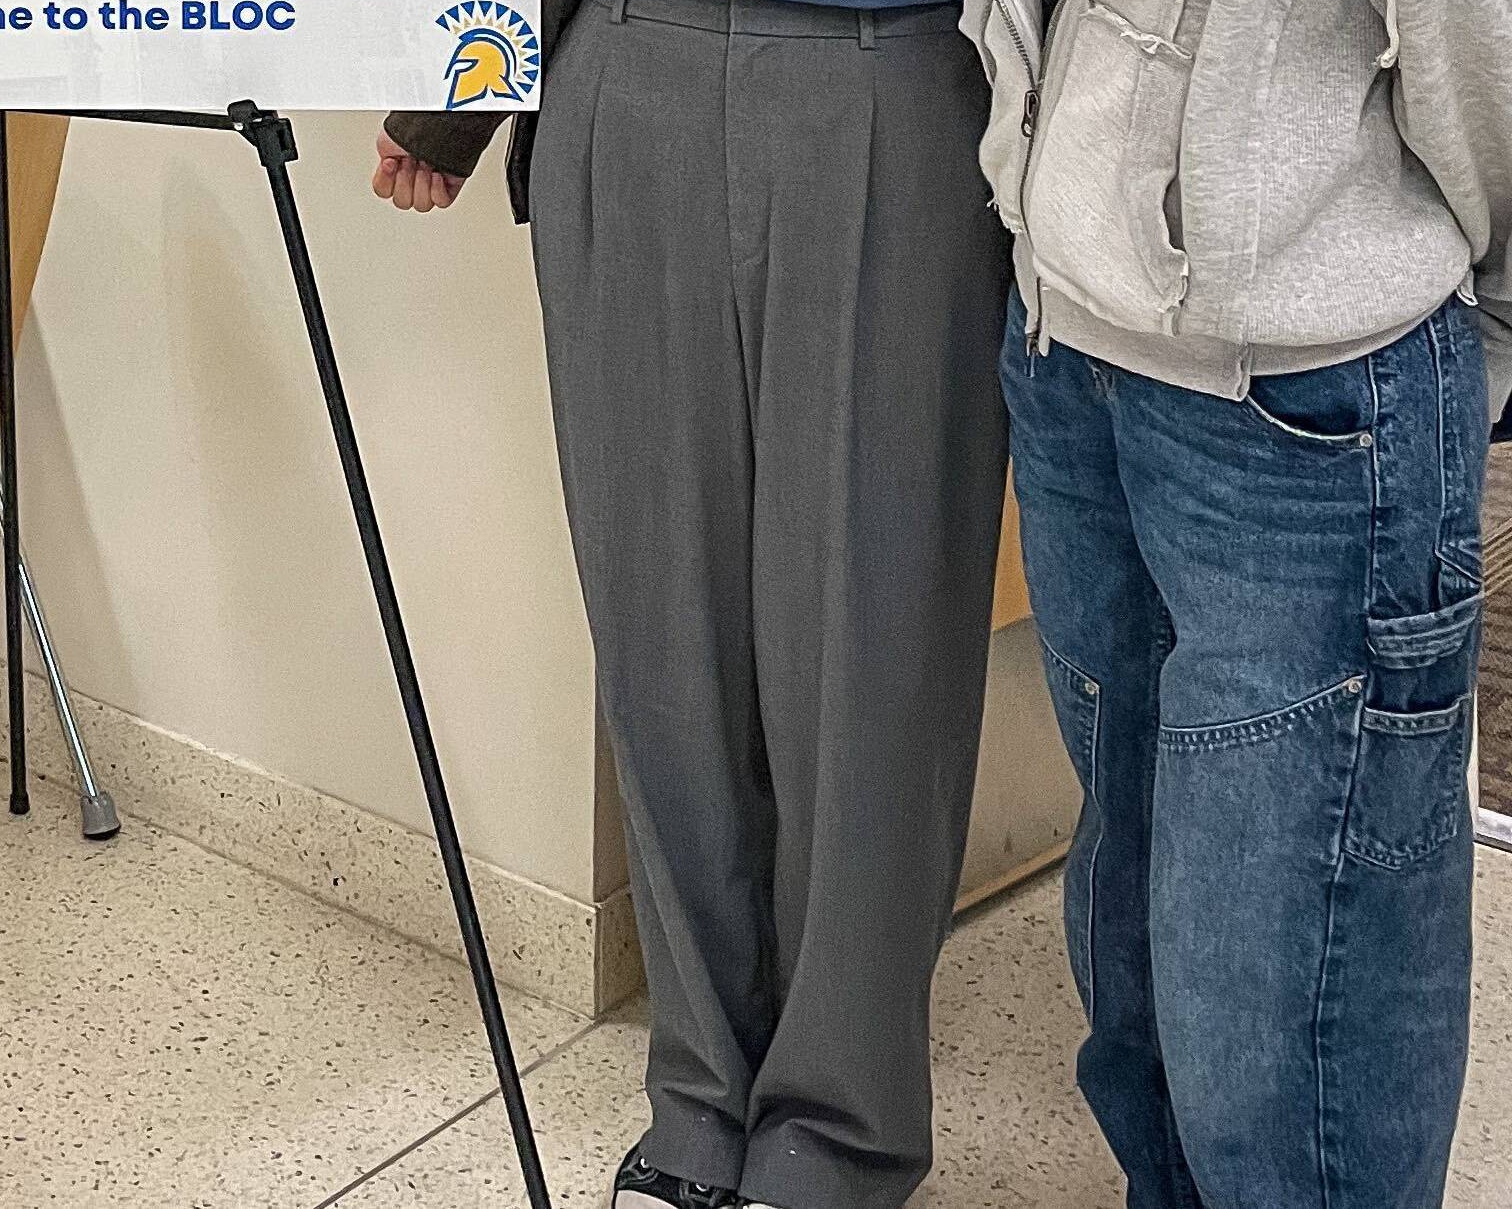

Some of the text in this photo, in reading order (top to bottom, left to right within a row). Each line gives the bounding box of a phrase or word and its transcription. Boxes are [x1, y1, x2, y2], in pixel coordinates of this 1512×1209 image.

[44, 3, 88, 30] to
[99, 0, 170, 30] the
[182, 1, 296, 31] BLOC
